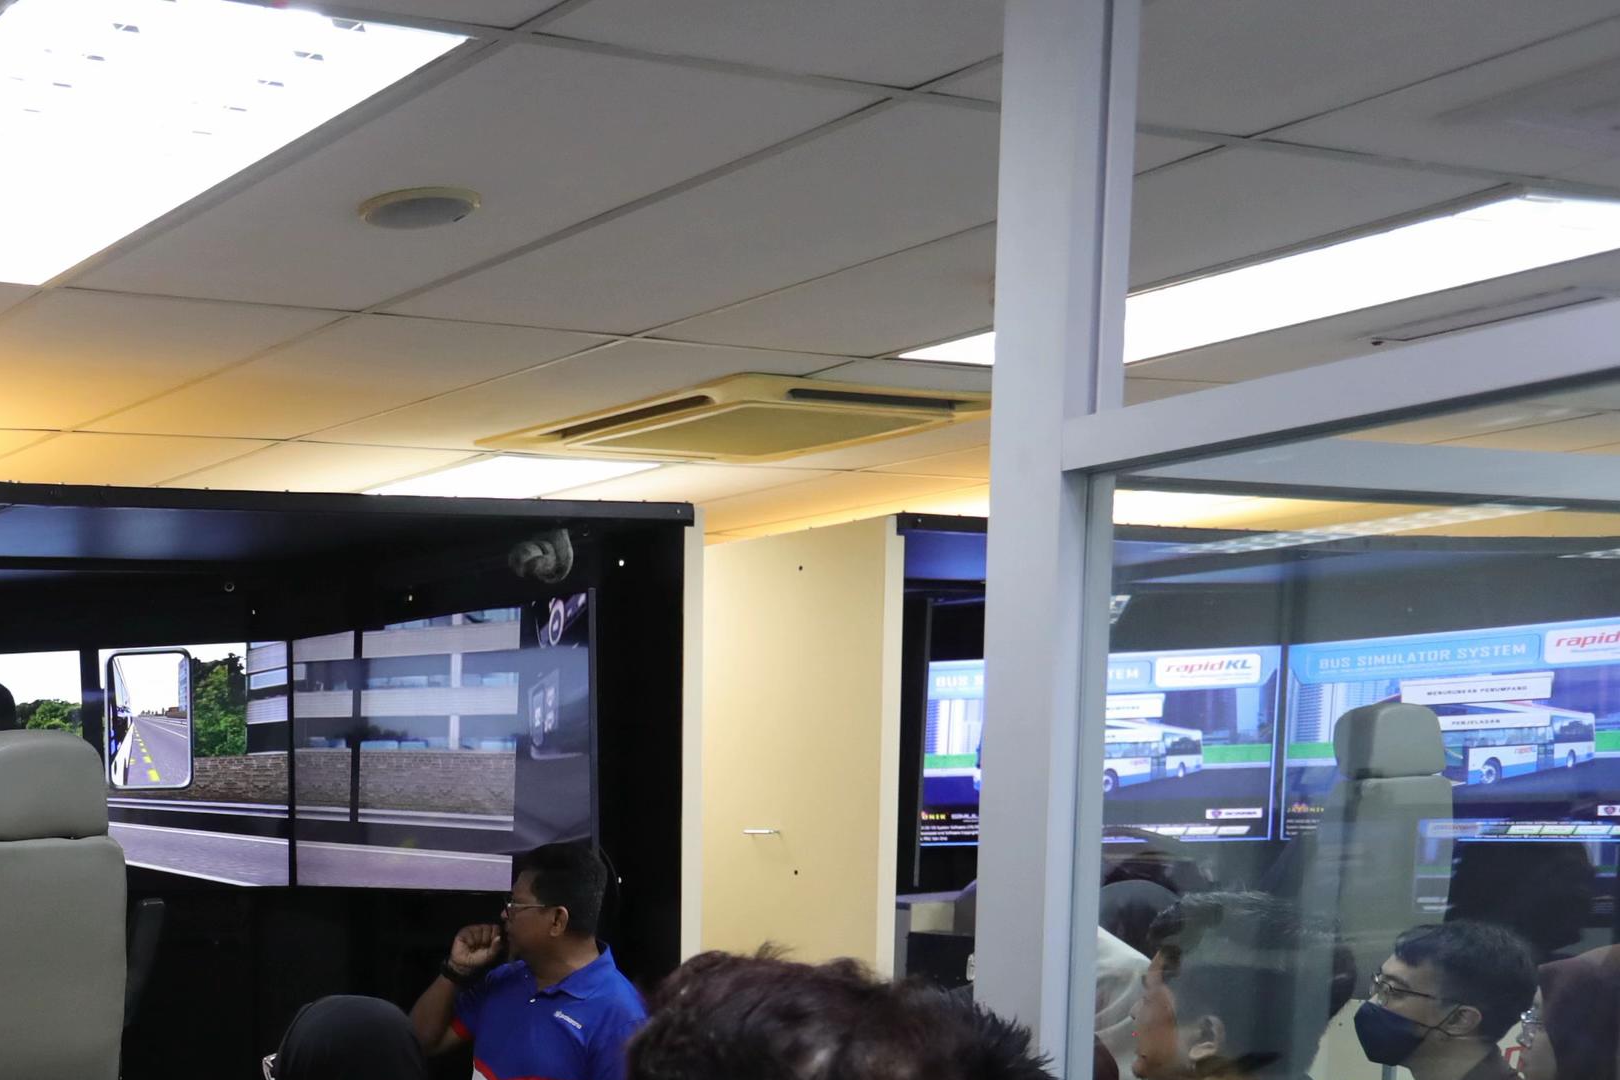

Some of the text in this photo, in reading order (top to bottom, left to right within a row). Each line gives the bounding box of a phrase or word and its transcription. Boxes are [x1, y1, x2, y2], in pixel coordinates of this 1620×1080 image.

[1318, 643, 1527, 670] BUS SIMULATOR SYSTEM
